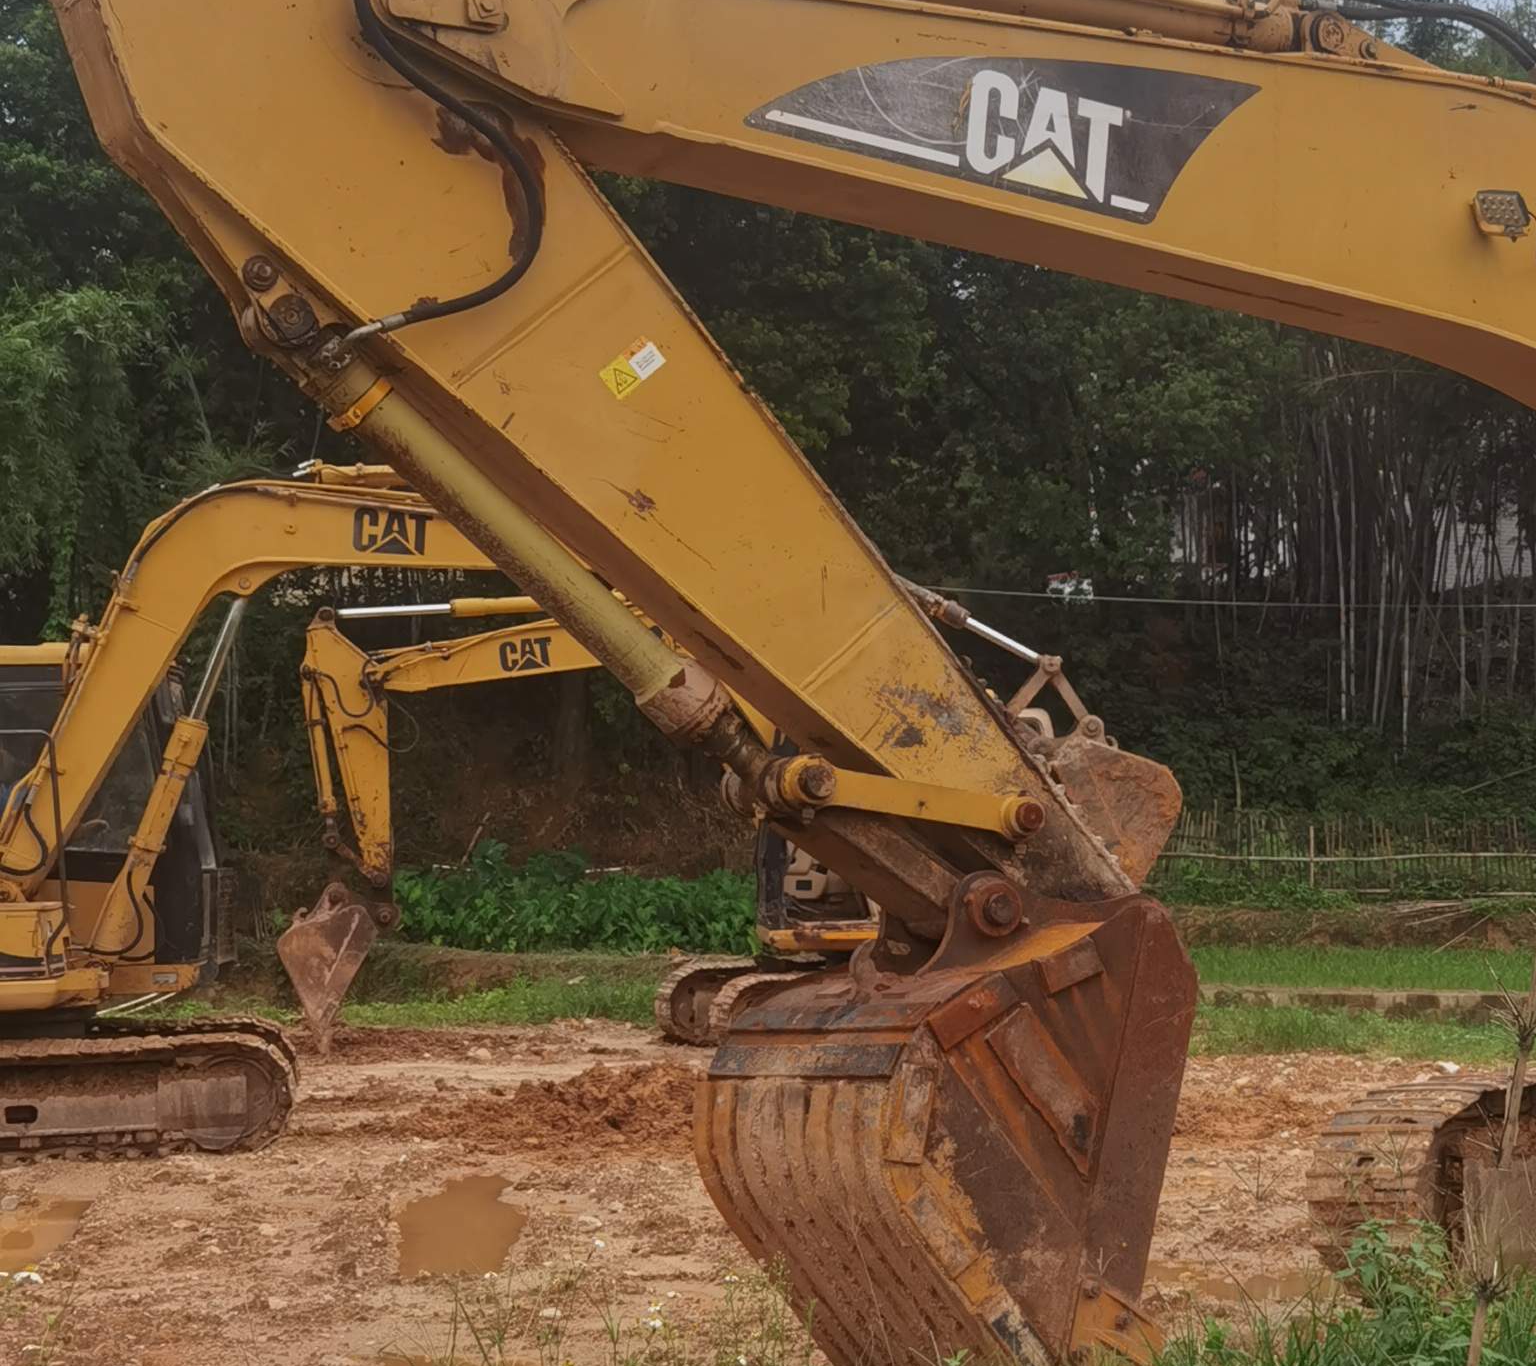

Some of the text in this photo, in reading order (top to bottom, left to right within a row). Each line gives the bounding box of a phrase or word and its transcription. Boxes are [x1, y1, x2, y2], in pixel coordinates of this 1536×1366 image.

[965, 69, 1124, 204] CAT
[353, 507, 433, 556] CAT
[499, 636, 552, 673] CAT
